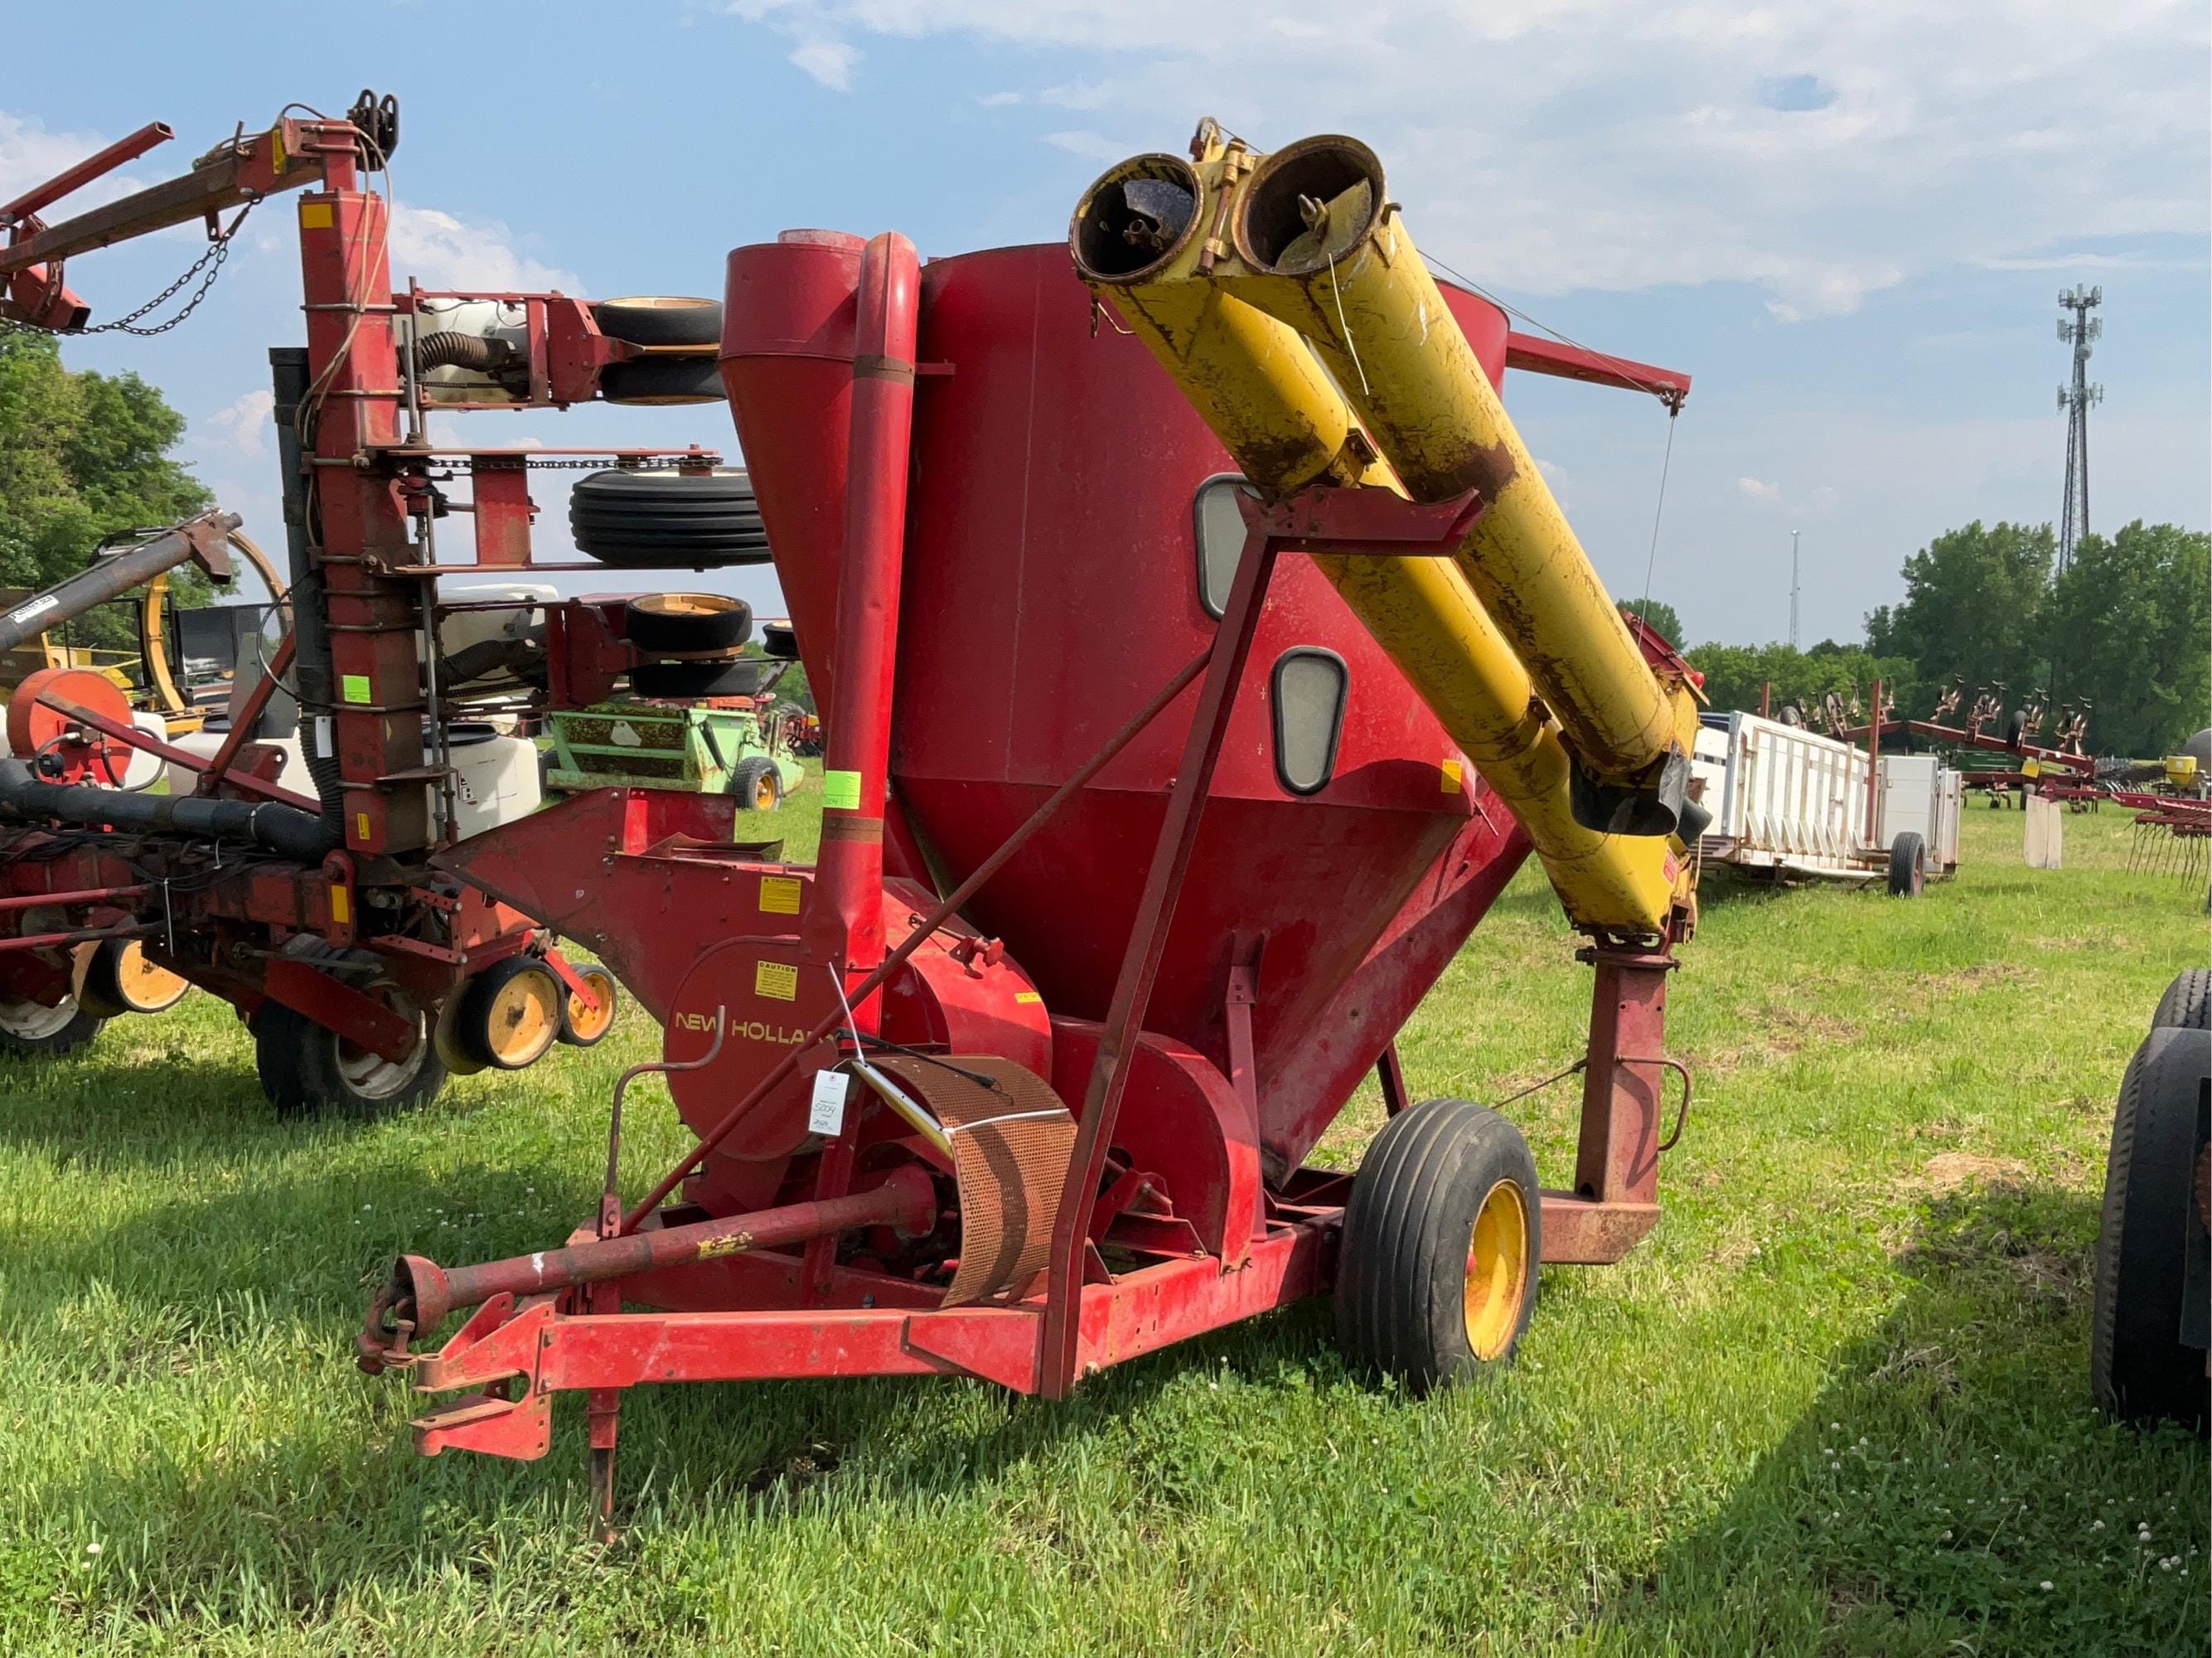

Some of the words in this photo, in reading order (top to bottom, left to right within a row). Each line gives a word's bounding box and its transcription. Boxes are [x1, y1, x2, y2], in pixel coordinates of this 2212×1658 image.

[759, 962, 796, 972] CAUTION
[675, 1012, 717, 1031] NEW
[732, 1020, 835, 1045] HOLLA
